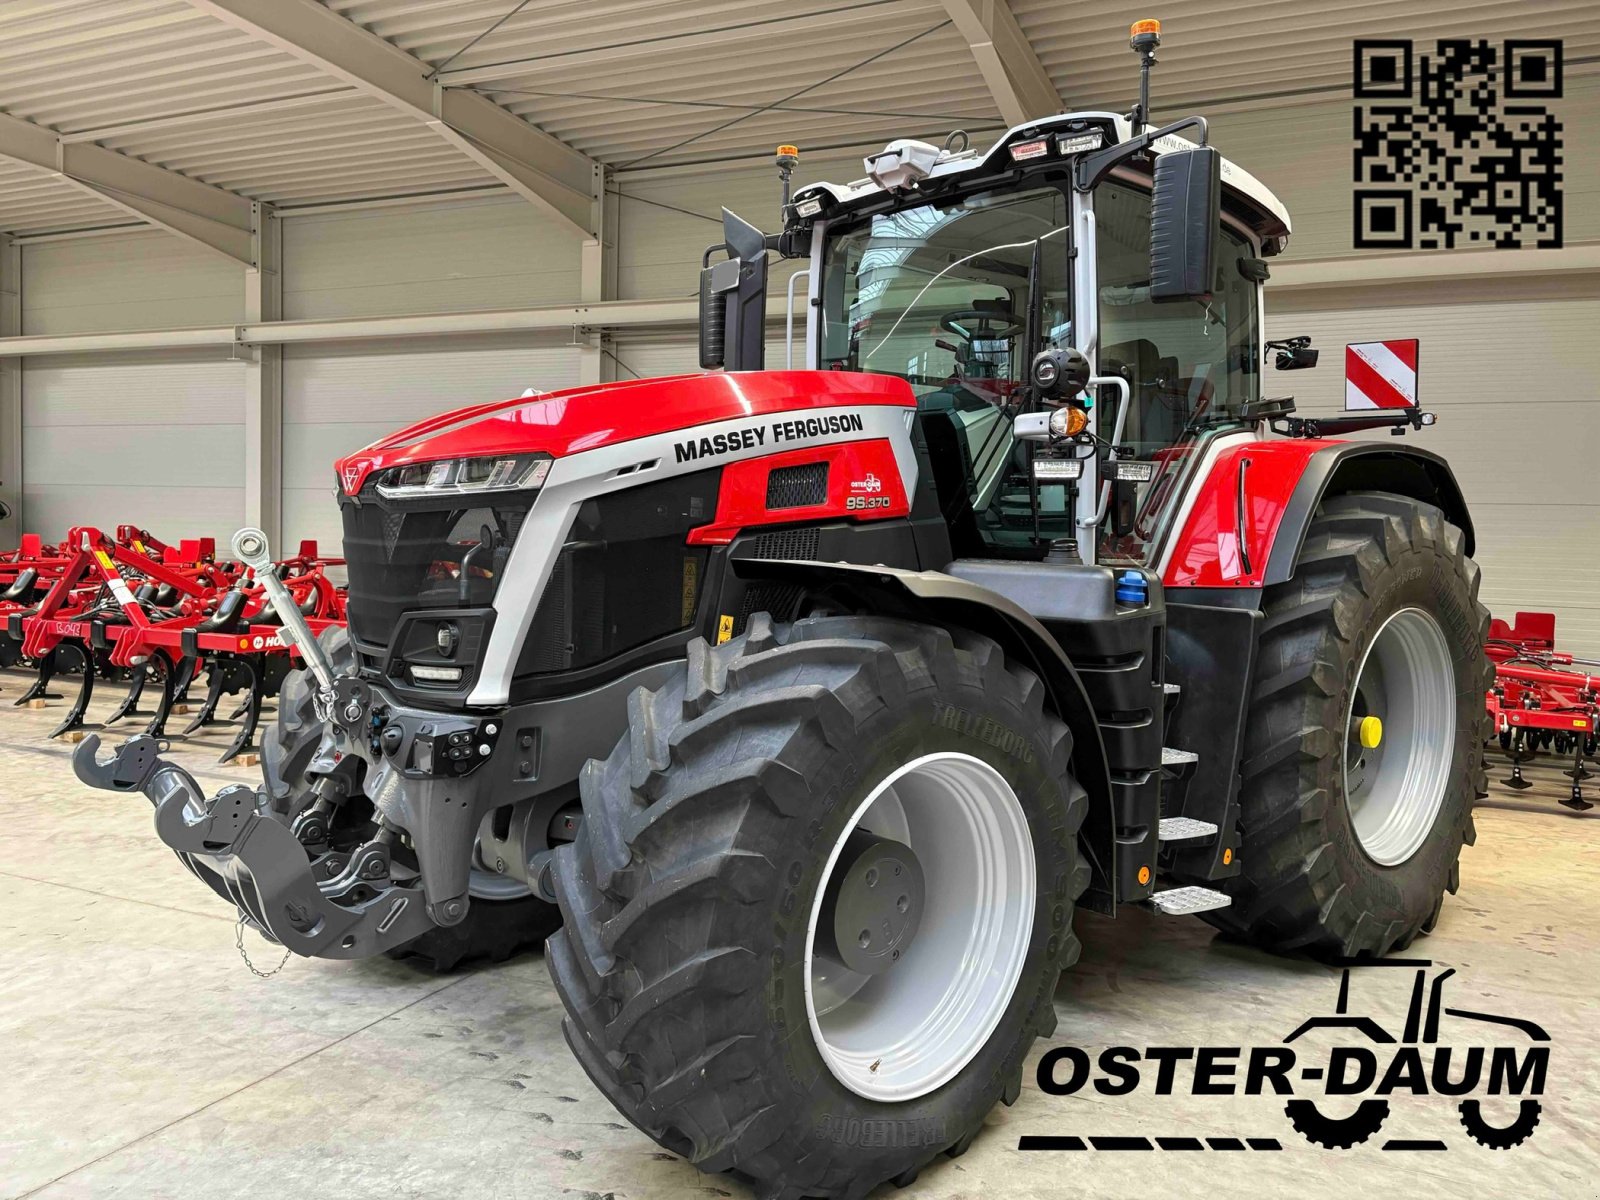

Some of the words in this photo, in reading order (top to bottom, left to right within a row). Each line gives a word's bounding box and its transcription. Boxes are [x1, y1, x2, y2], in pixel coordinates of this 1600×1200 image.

[675, 426, 766, 462] MASSEY
[773, 414, 863, 442] FERGUSON
[846, 496, 890, 510] 9S.370
